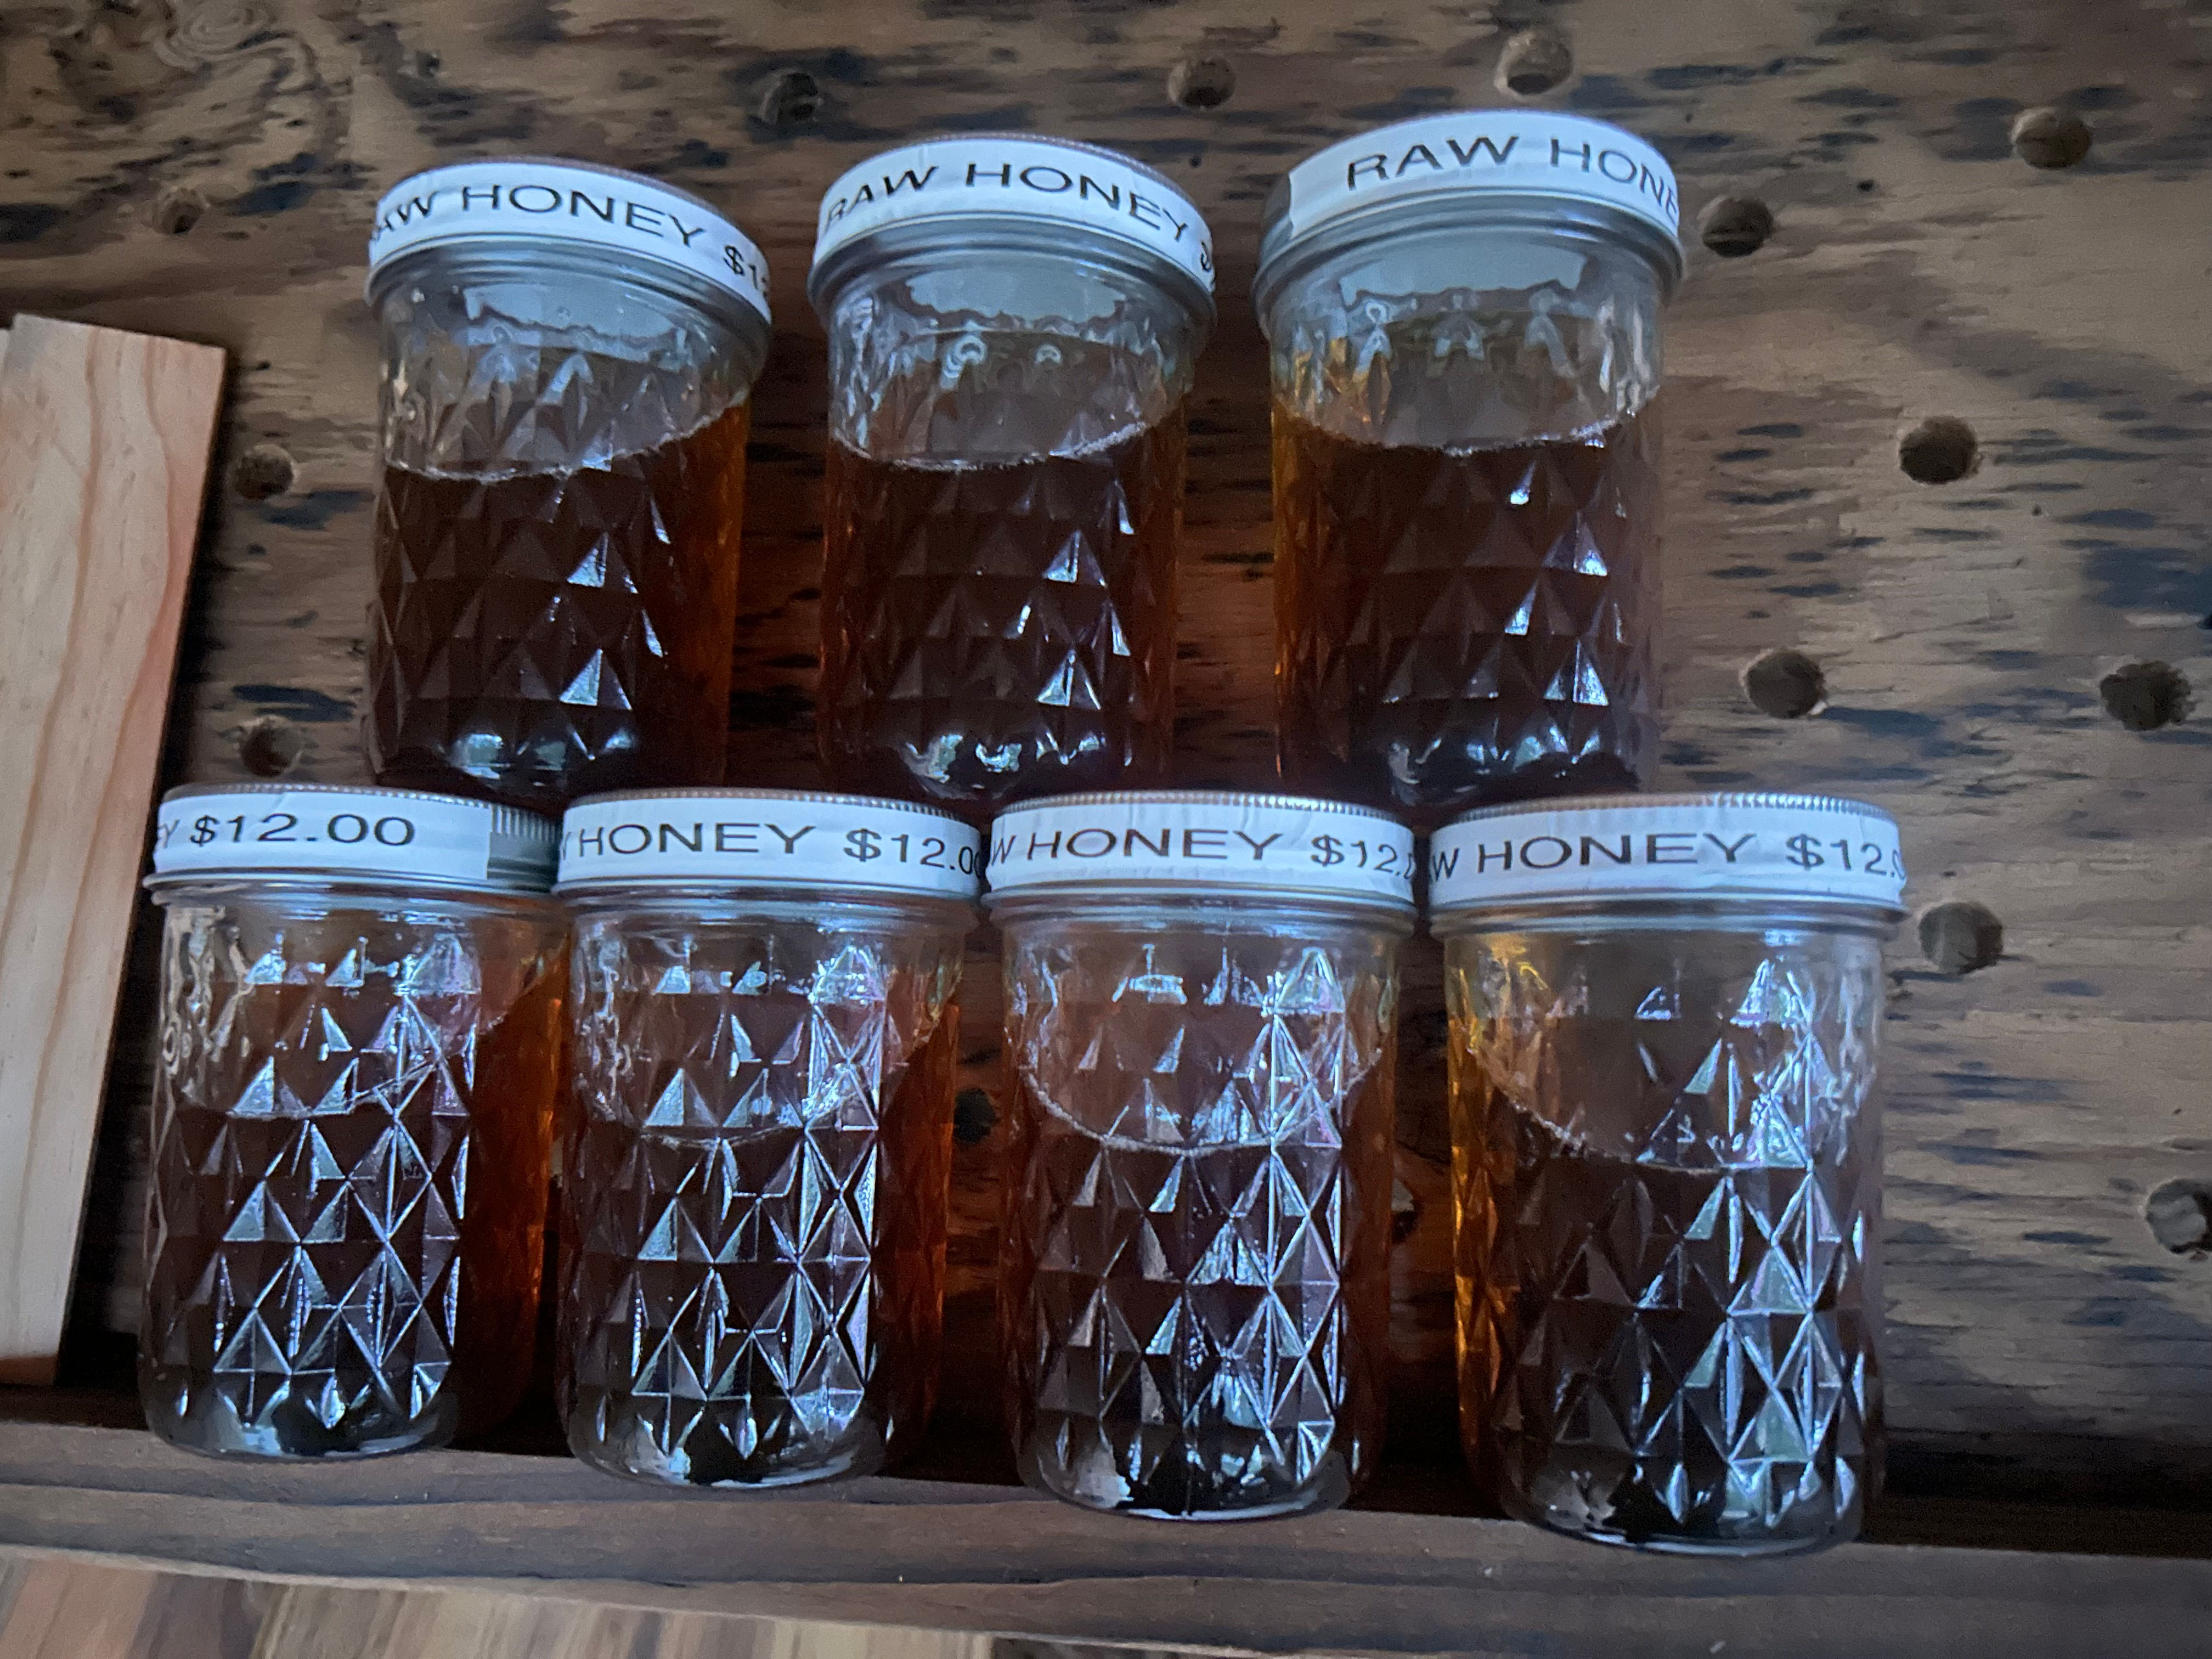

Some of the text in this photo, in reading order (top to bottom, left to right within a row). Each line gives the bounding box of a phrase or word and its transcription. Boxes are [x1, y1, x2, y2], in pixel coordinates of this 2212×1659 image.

[1347, 136, 1519, 191] RAW
[370, 190, 438, 240] AW
[462, 184, 704, 246] HONEY
[824, 163, 1188, 242] RAW HONEY
[189, 812, 415, 847] $12.00
[579, 822, 816, 857] HONEY
[1027, 828, 1283, 861] HONEY
[1477, 832, 1756, 873] HONEY
